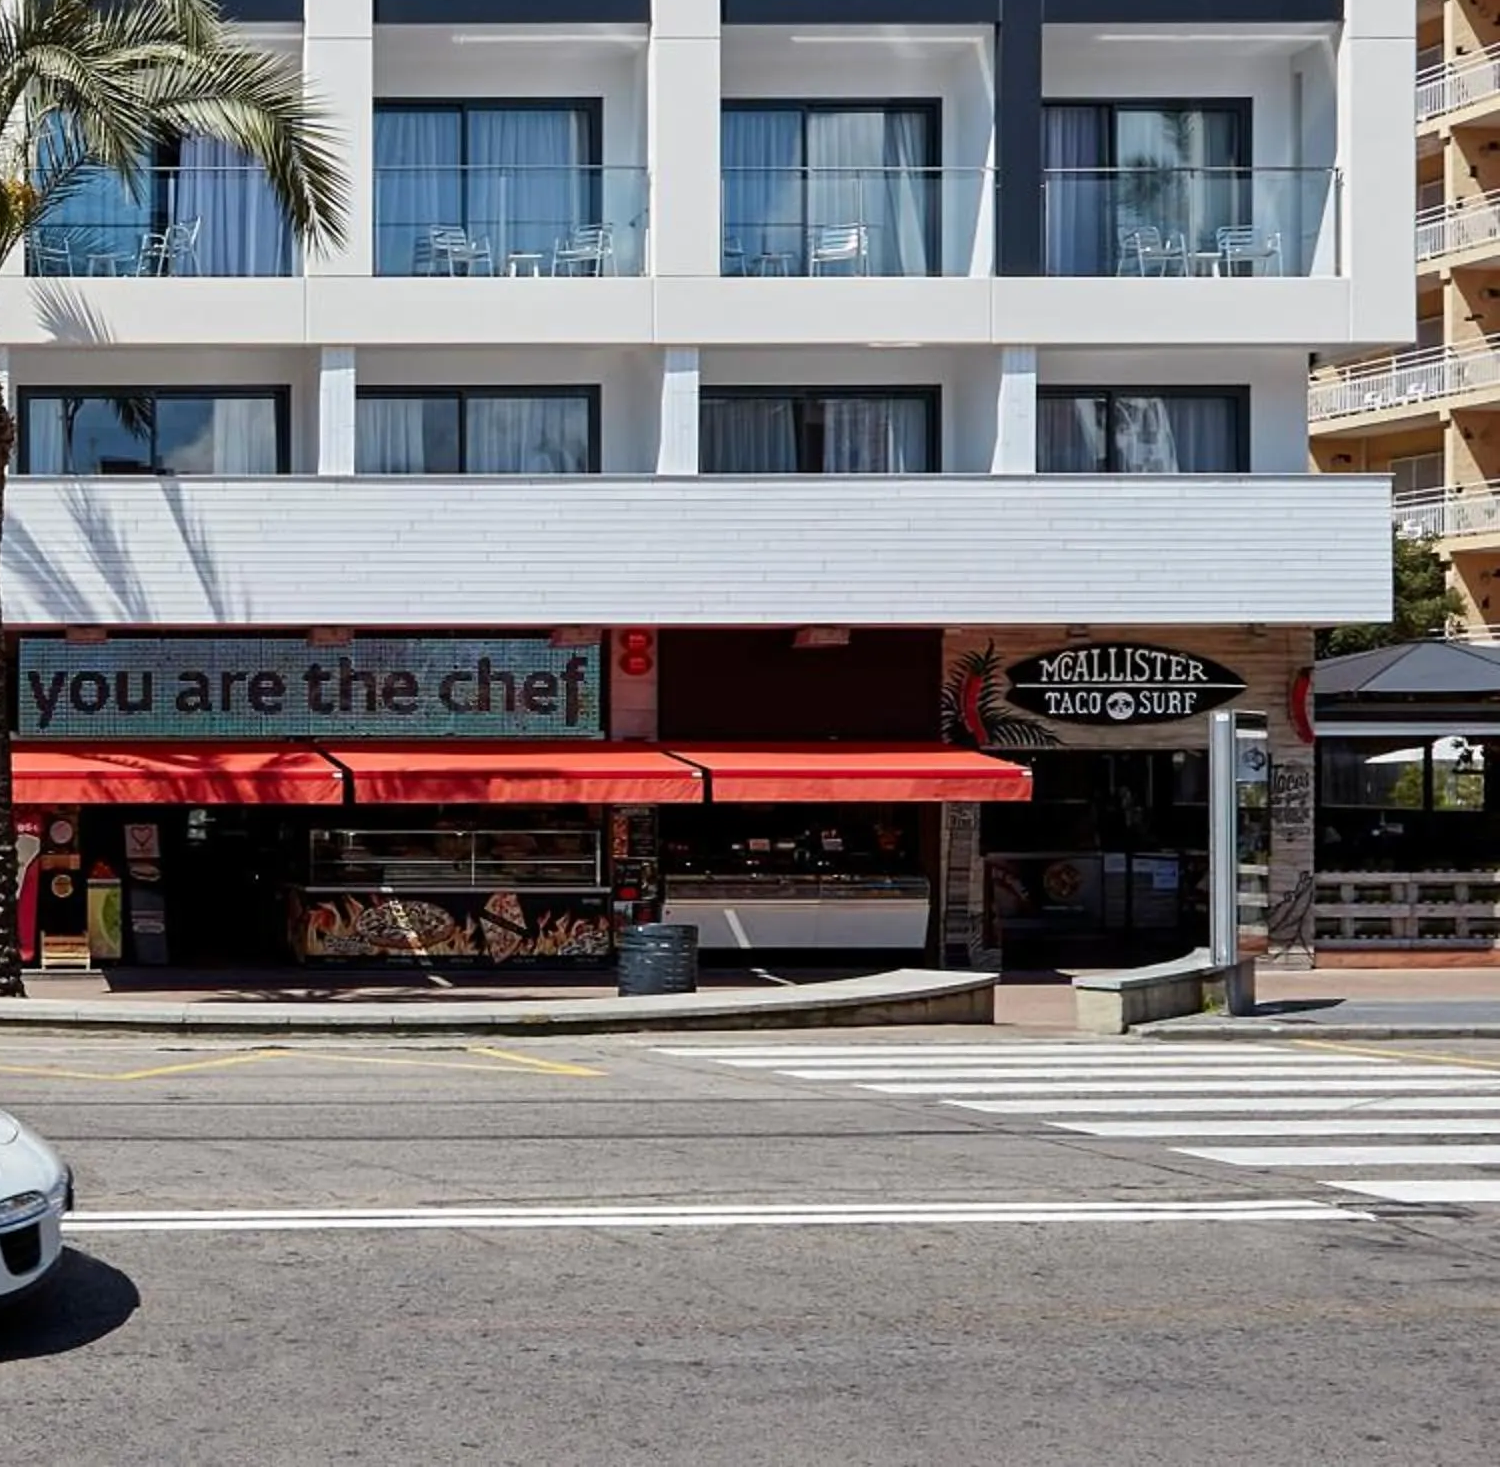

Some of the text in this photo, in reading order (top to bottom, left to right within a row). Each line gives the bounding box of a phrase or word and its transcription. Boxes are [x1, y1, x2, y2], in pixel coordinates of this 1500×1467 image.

[27, 656, 588, 729] you are the chef
[1045, 690, 1197, 715] TACO SURF
